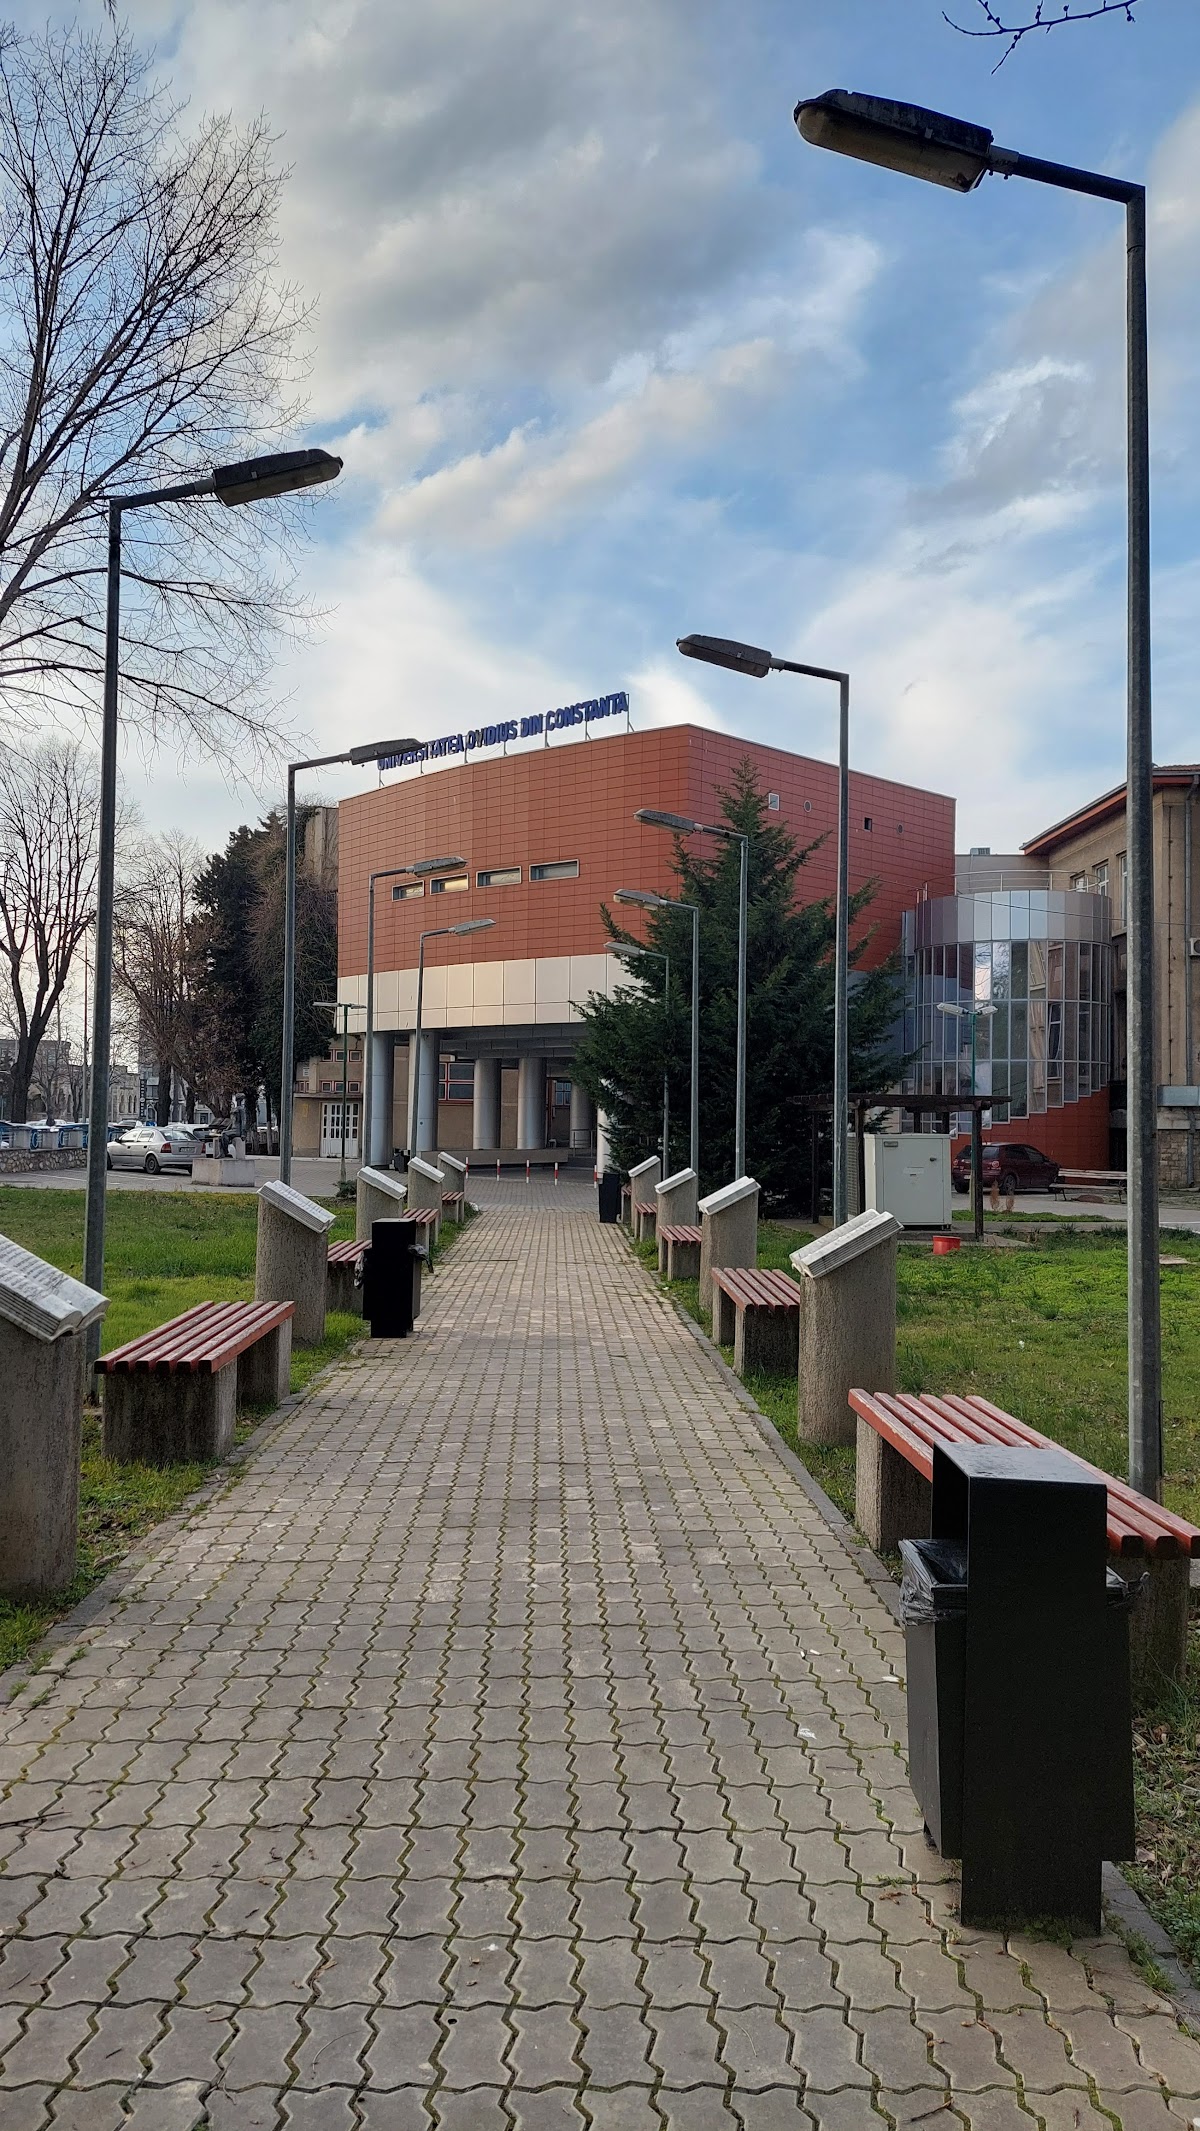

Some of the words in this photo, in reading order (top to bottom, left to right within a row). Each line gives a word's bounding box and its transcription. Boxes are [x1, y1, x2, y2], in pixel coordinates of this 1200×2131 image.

[467, 720, 517, 749] OVIDIUS
[521, 714, 543, 738] DIN
[546, 691, 628, 731] CONSTANTA
